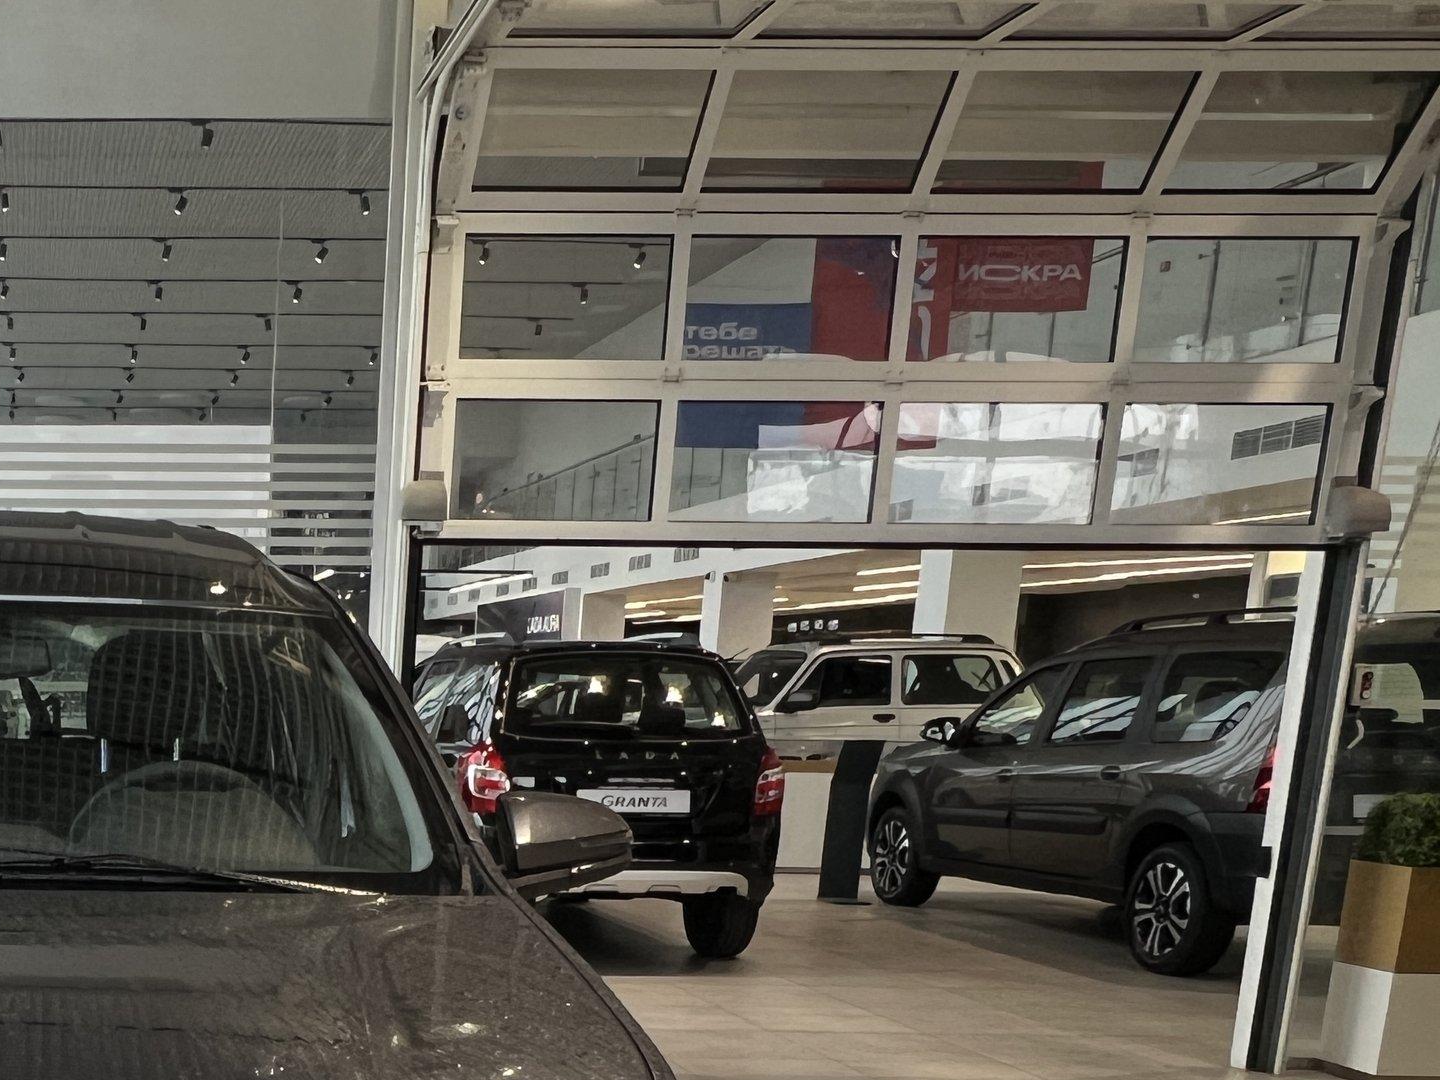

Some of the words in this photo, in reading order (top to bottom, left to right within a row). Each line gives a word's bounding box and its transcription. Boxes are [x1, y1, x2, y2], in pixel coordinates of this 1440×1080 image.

[958, 263, 1082, 282] ИСКРА
[685, 321, 758, 340] тебе
[594, 749, 679, 760] LADA
[601, 795, 668, 808] GRANTA
